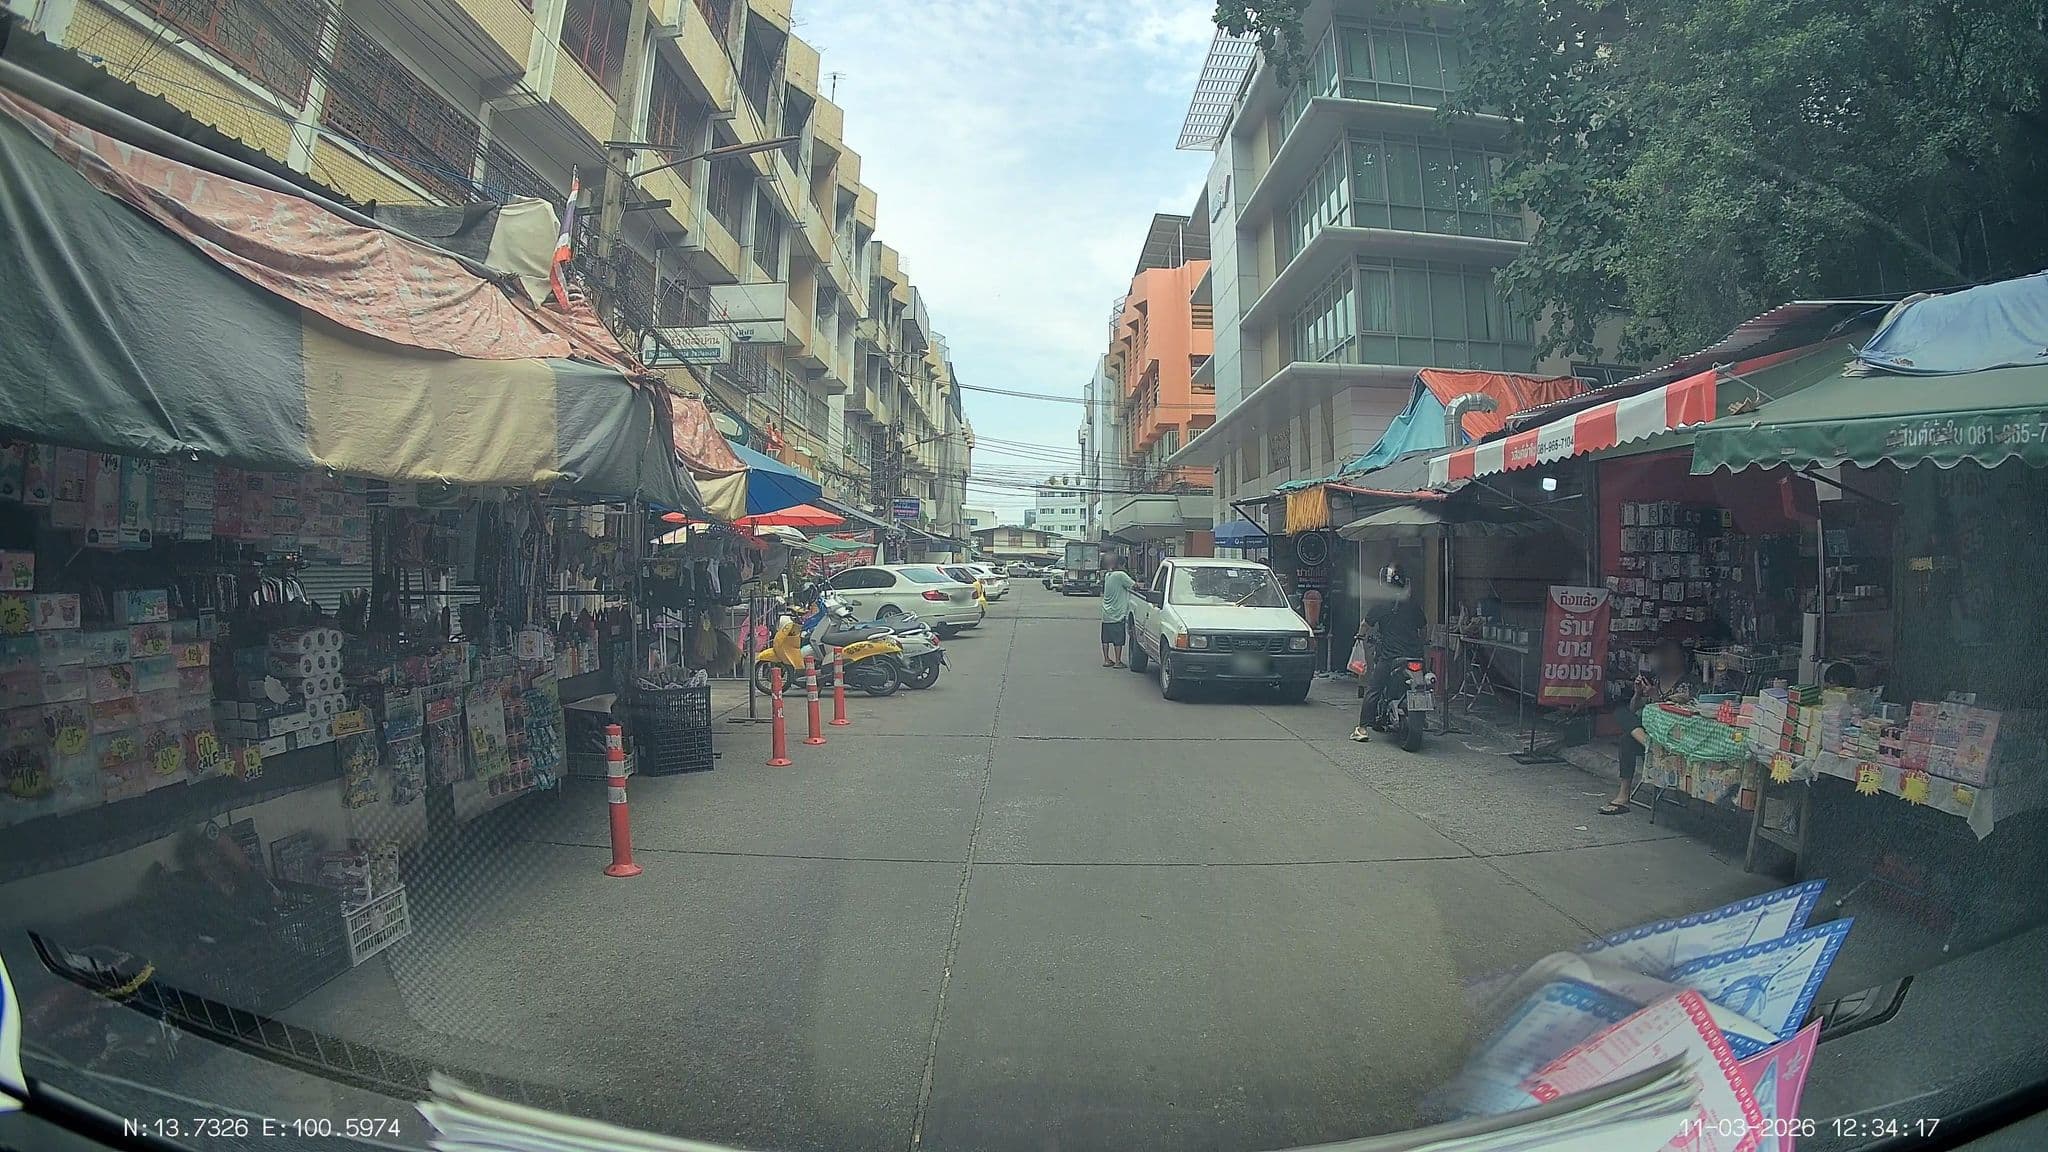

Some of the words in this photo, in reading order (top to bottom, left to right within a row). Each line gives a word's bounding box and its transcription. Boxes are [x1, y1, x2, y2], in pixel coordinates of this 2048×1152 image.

[1560, 591, 1598, 606] ถึงแล้ว
[1559, 613, 1594, 636] ร้าน
[1557, 640, 1592, 657] ขาย
[197, 750, 218, 773] SALE
